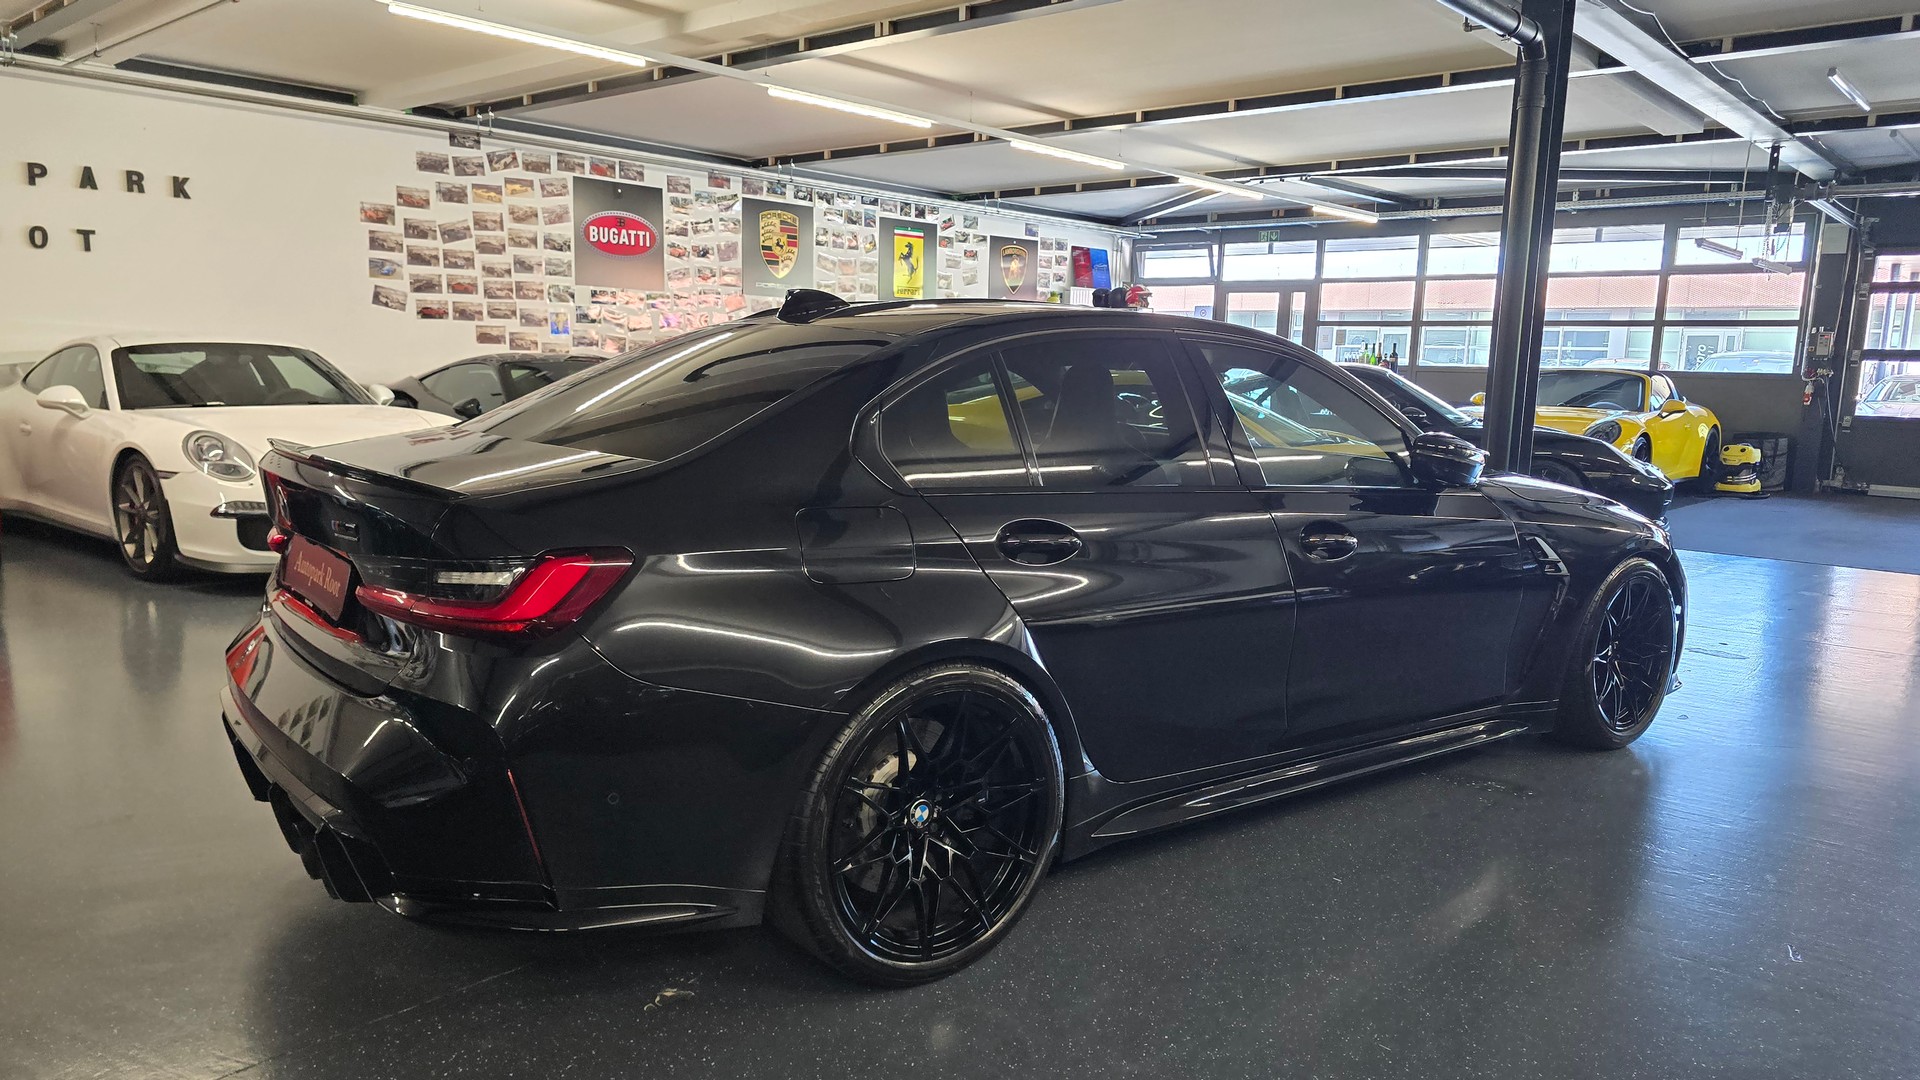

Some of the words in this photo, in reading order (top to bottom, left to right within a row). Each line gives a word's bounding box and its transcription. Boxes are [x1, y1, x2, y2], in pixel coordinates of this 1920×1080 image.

[27, 162, 192, 200] PARK
[760, 212, 798, 224] PORSCHE
[589, 226, 651, 248] BUGATTI
[897, 286, 923, 296] Ferrari
[294, 551, 325, 586] Autopark
